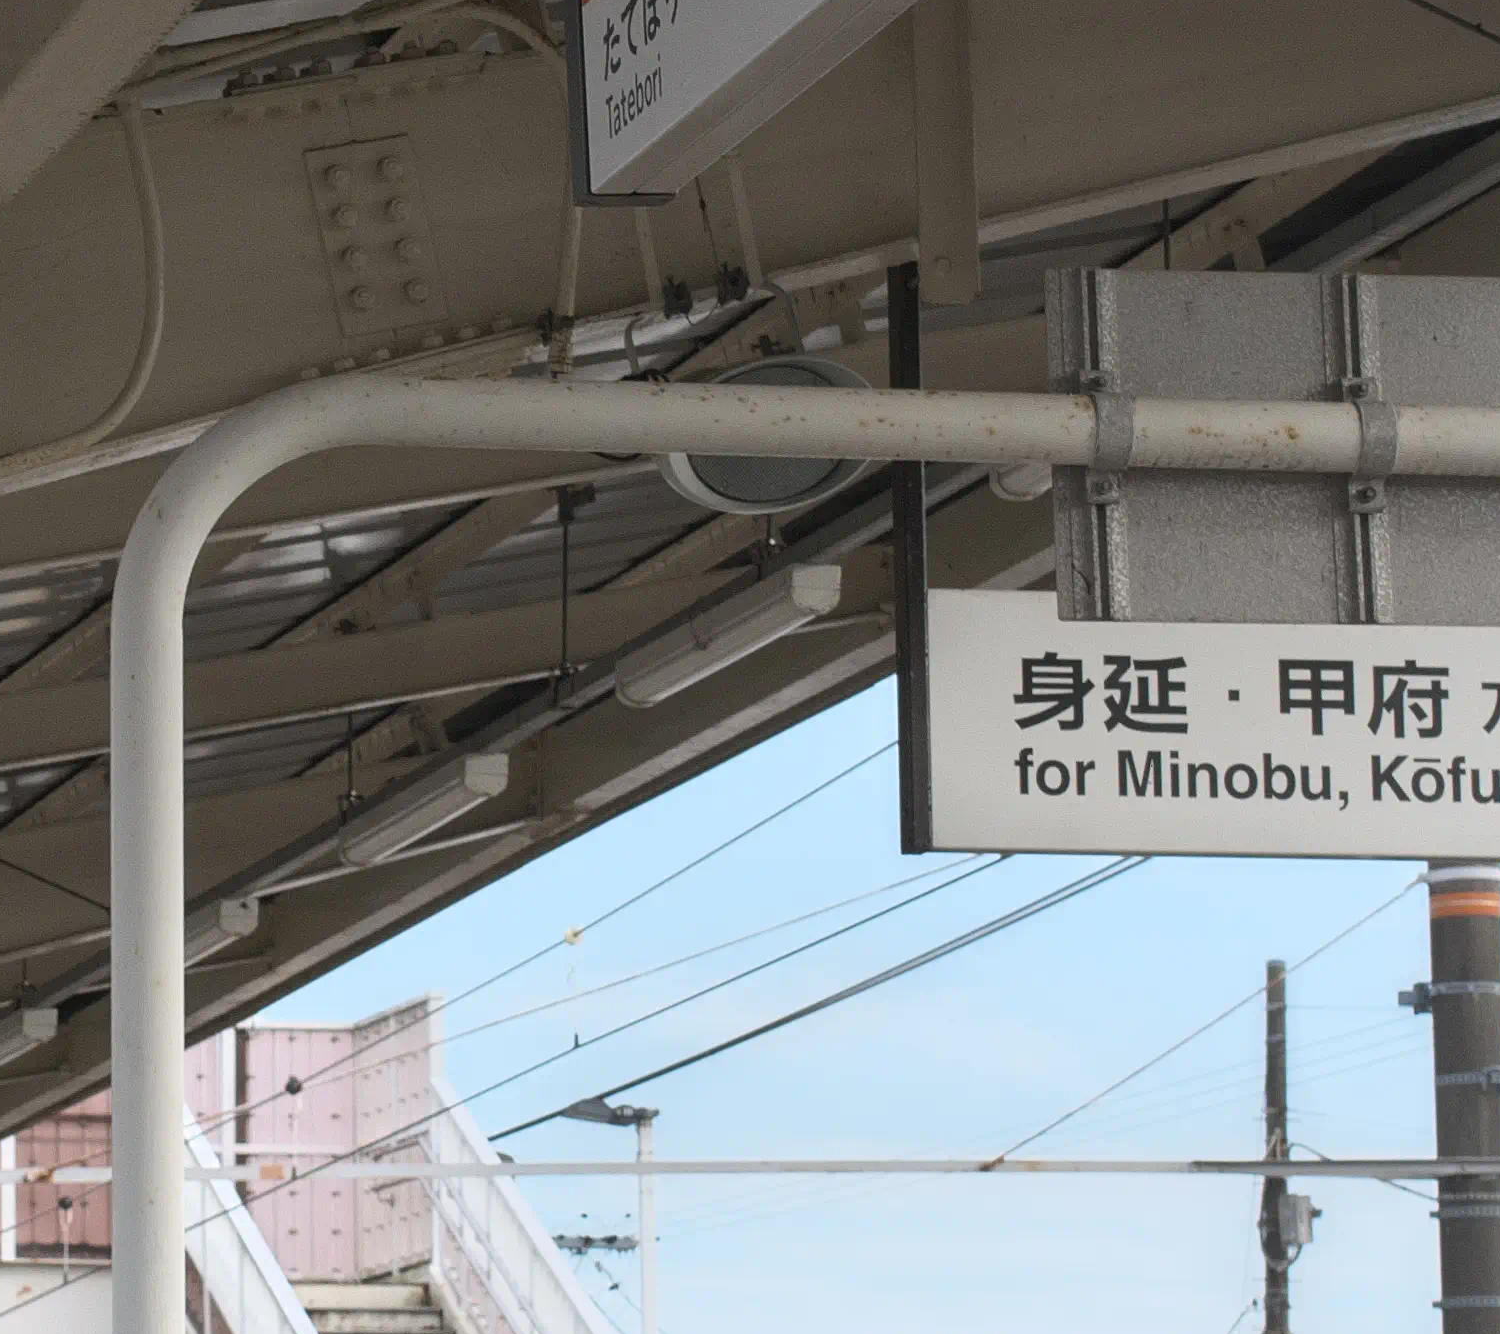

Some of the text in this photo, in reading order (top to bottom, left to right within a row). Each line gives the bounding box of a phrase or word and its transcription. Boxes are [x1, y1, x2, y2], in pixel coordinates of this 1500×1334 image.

[605, 53, 663, 139] Tatebori
[1013, 747, 1096, 798] for
[1114, 750, 1352, 812] Minobu,
